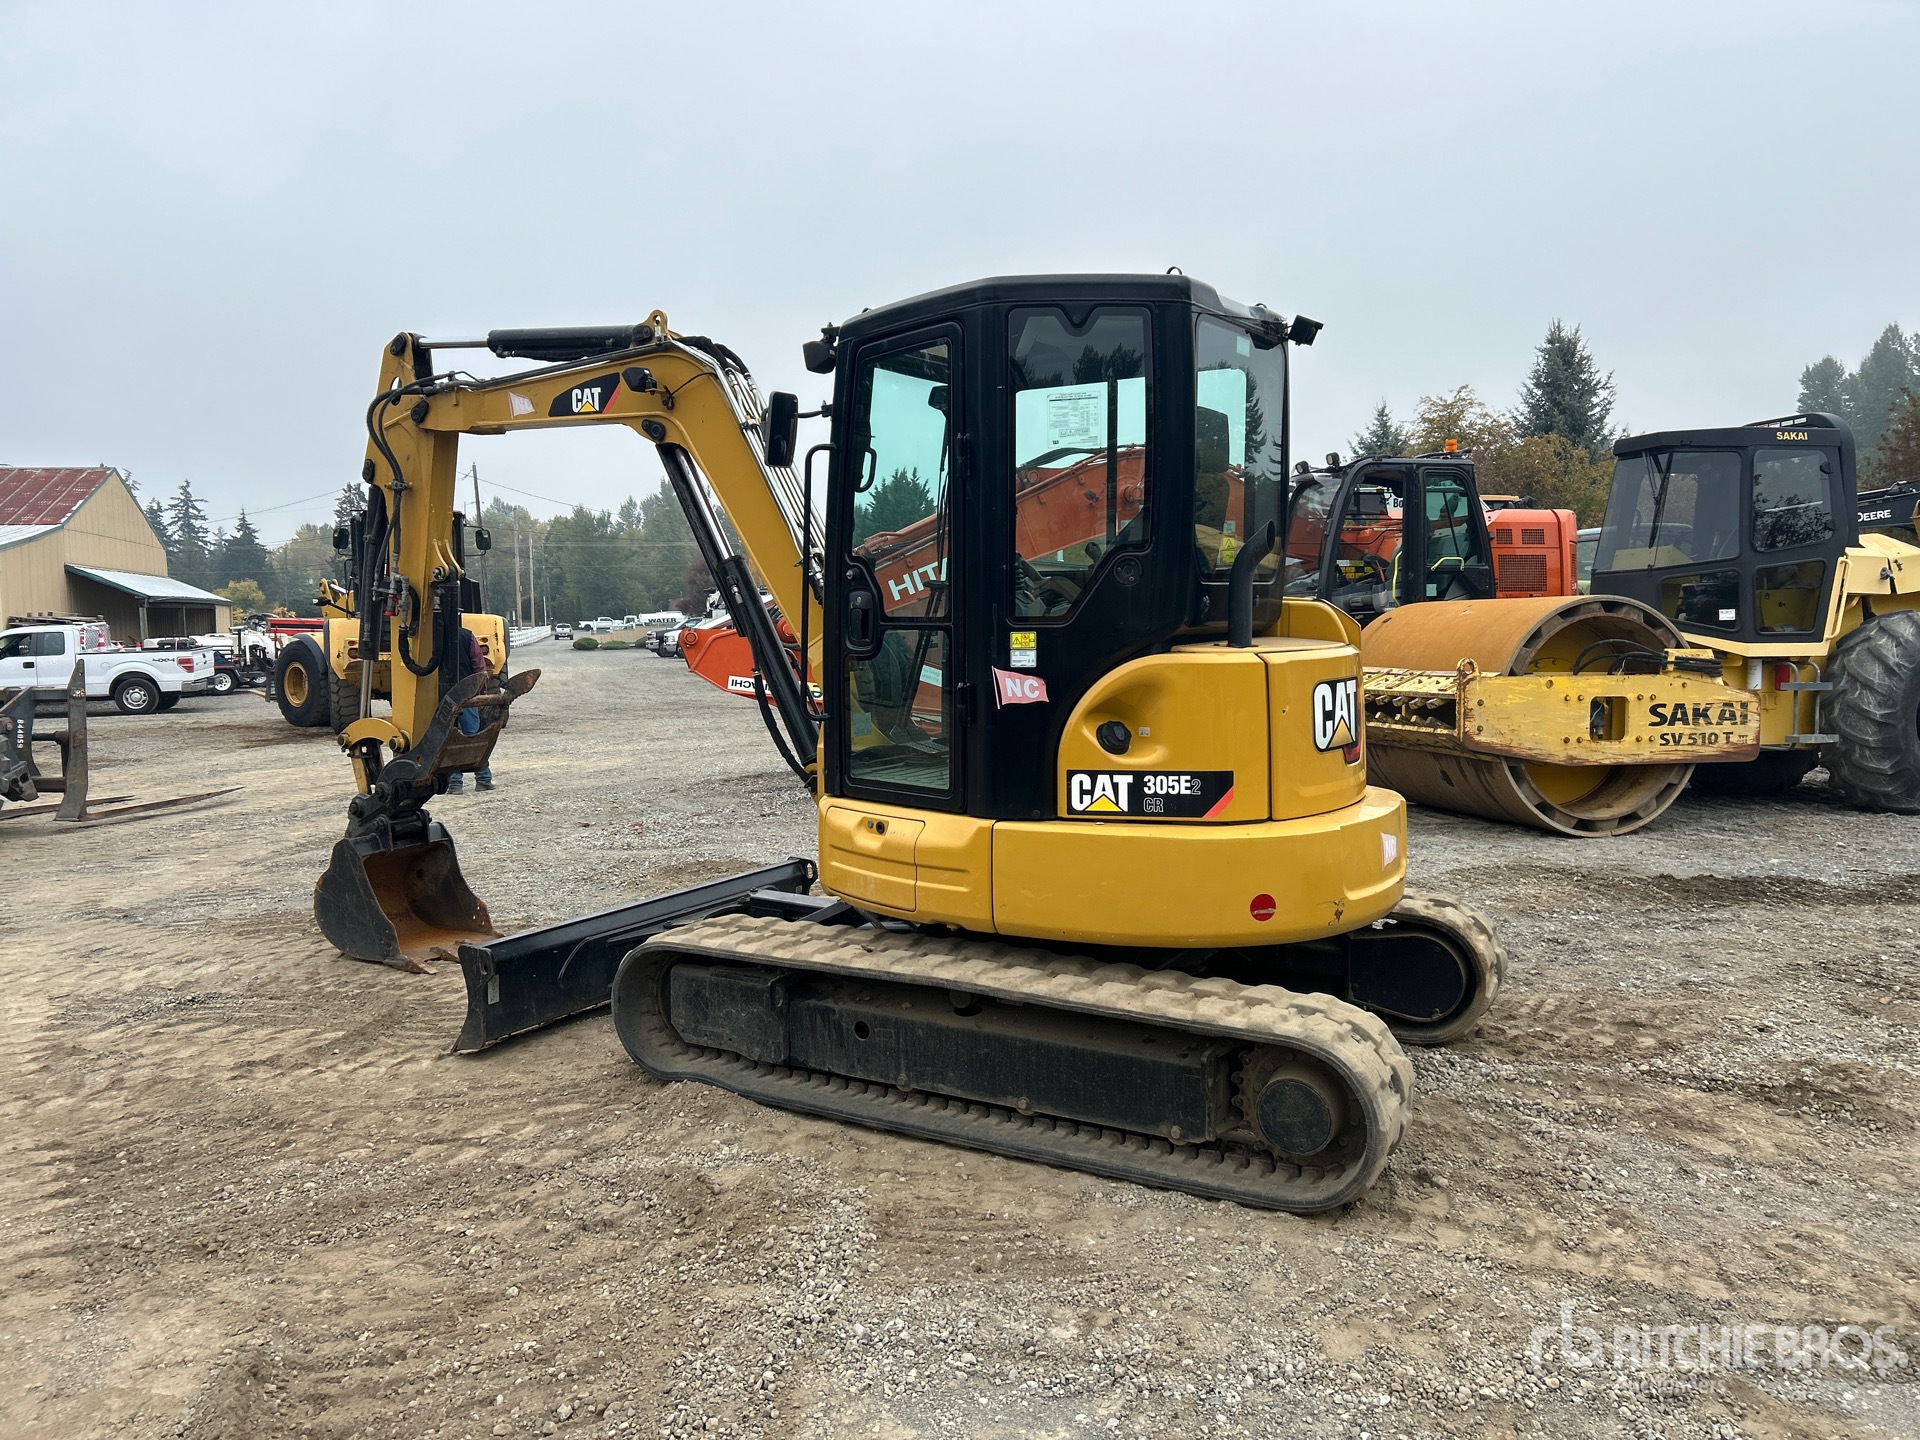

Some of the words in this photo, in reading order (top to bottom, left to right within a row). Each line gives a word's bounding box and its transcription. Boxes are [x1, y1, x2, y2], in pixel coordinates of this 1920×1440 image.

[571, 387, 601, 413] CAT
[1776, 432, 1808, 440] SAKAI
[1857, 509, 1892, 522] DEERE
[1005, 677, 1040, 699] NC
[1314, 680, 1357, 749] CAT
[1648, 700, 1748, 727] SAKAI
[16, 719, 24, 749] 844059
[1070, 773, 1134, 812] CAT
[1143, 798, 1164, 812] CR
